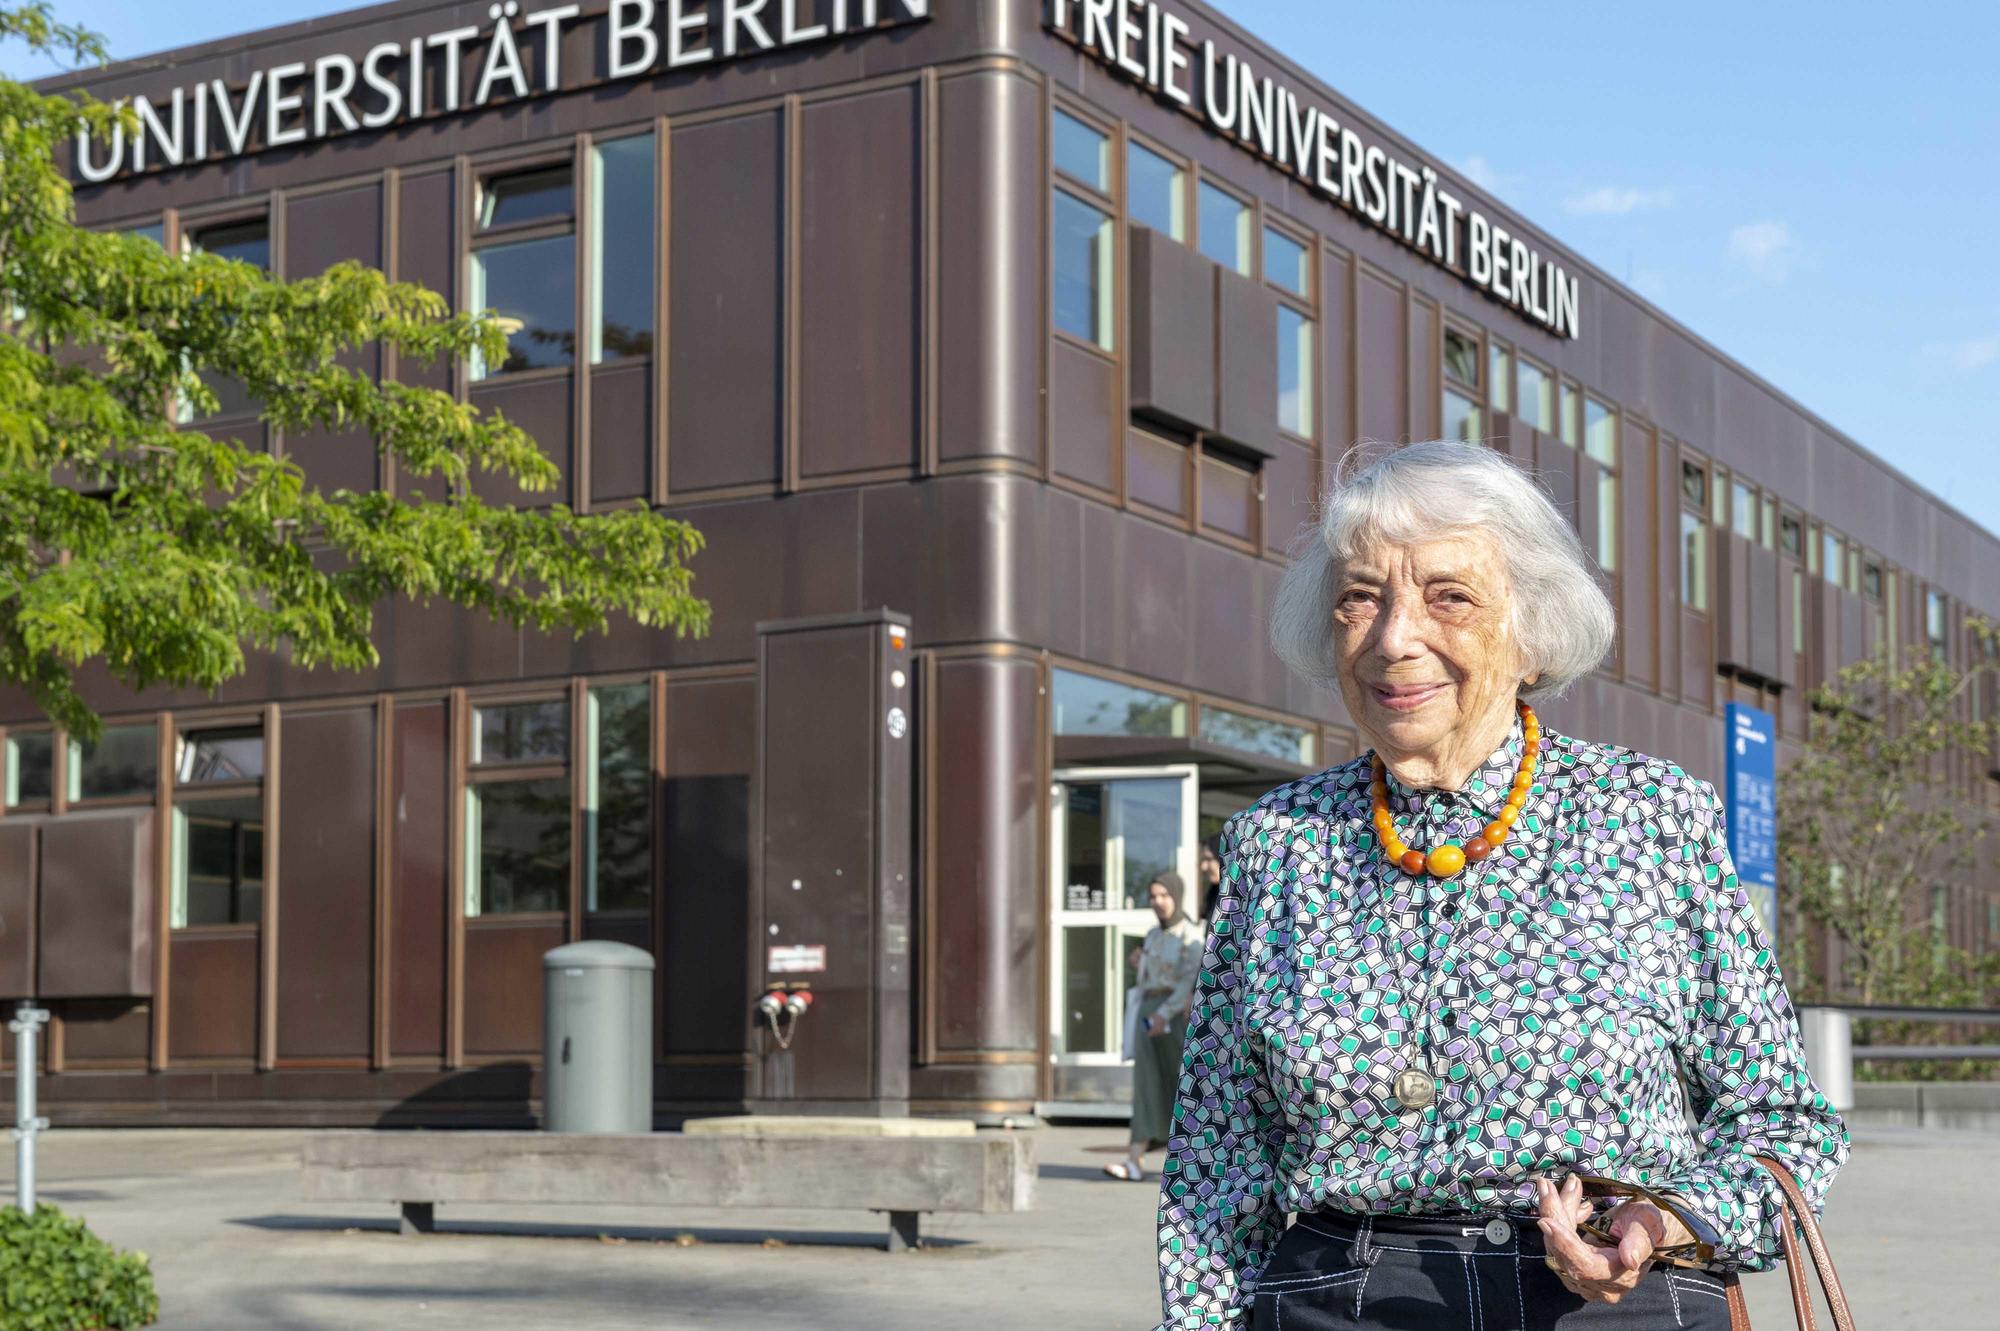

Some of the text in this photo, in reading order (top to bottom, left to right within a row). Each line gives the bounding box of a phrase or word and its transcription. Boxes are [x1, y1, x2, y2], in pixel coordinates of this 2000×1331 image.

[77, 1, 580, 182] UNIVERSITÄT
[1204, 39, 1463, 267] UNIVERSITÄT
[1469, 211, 1580, 341] BERLIN
